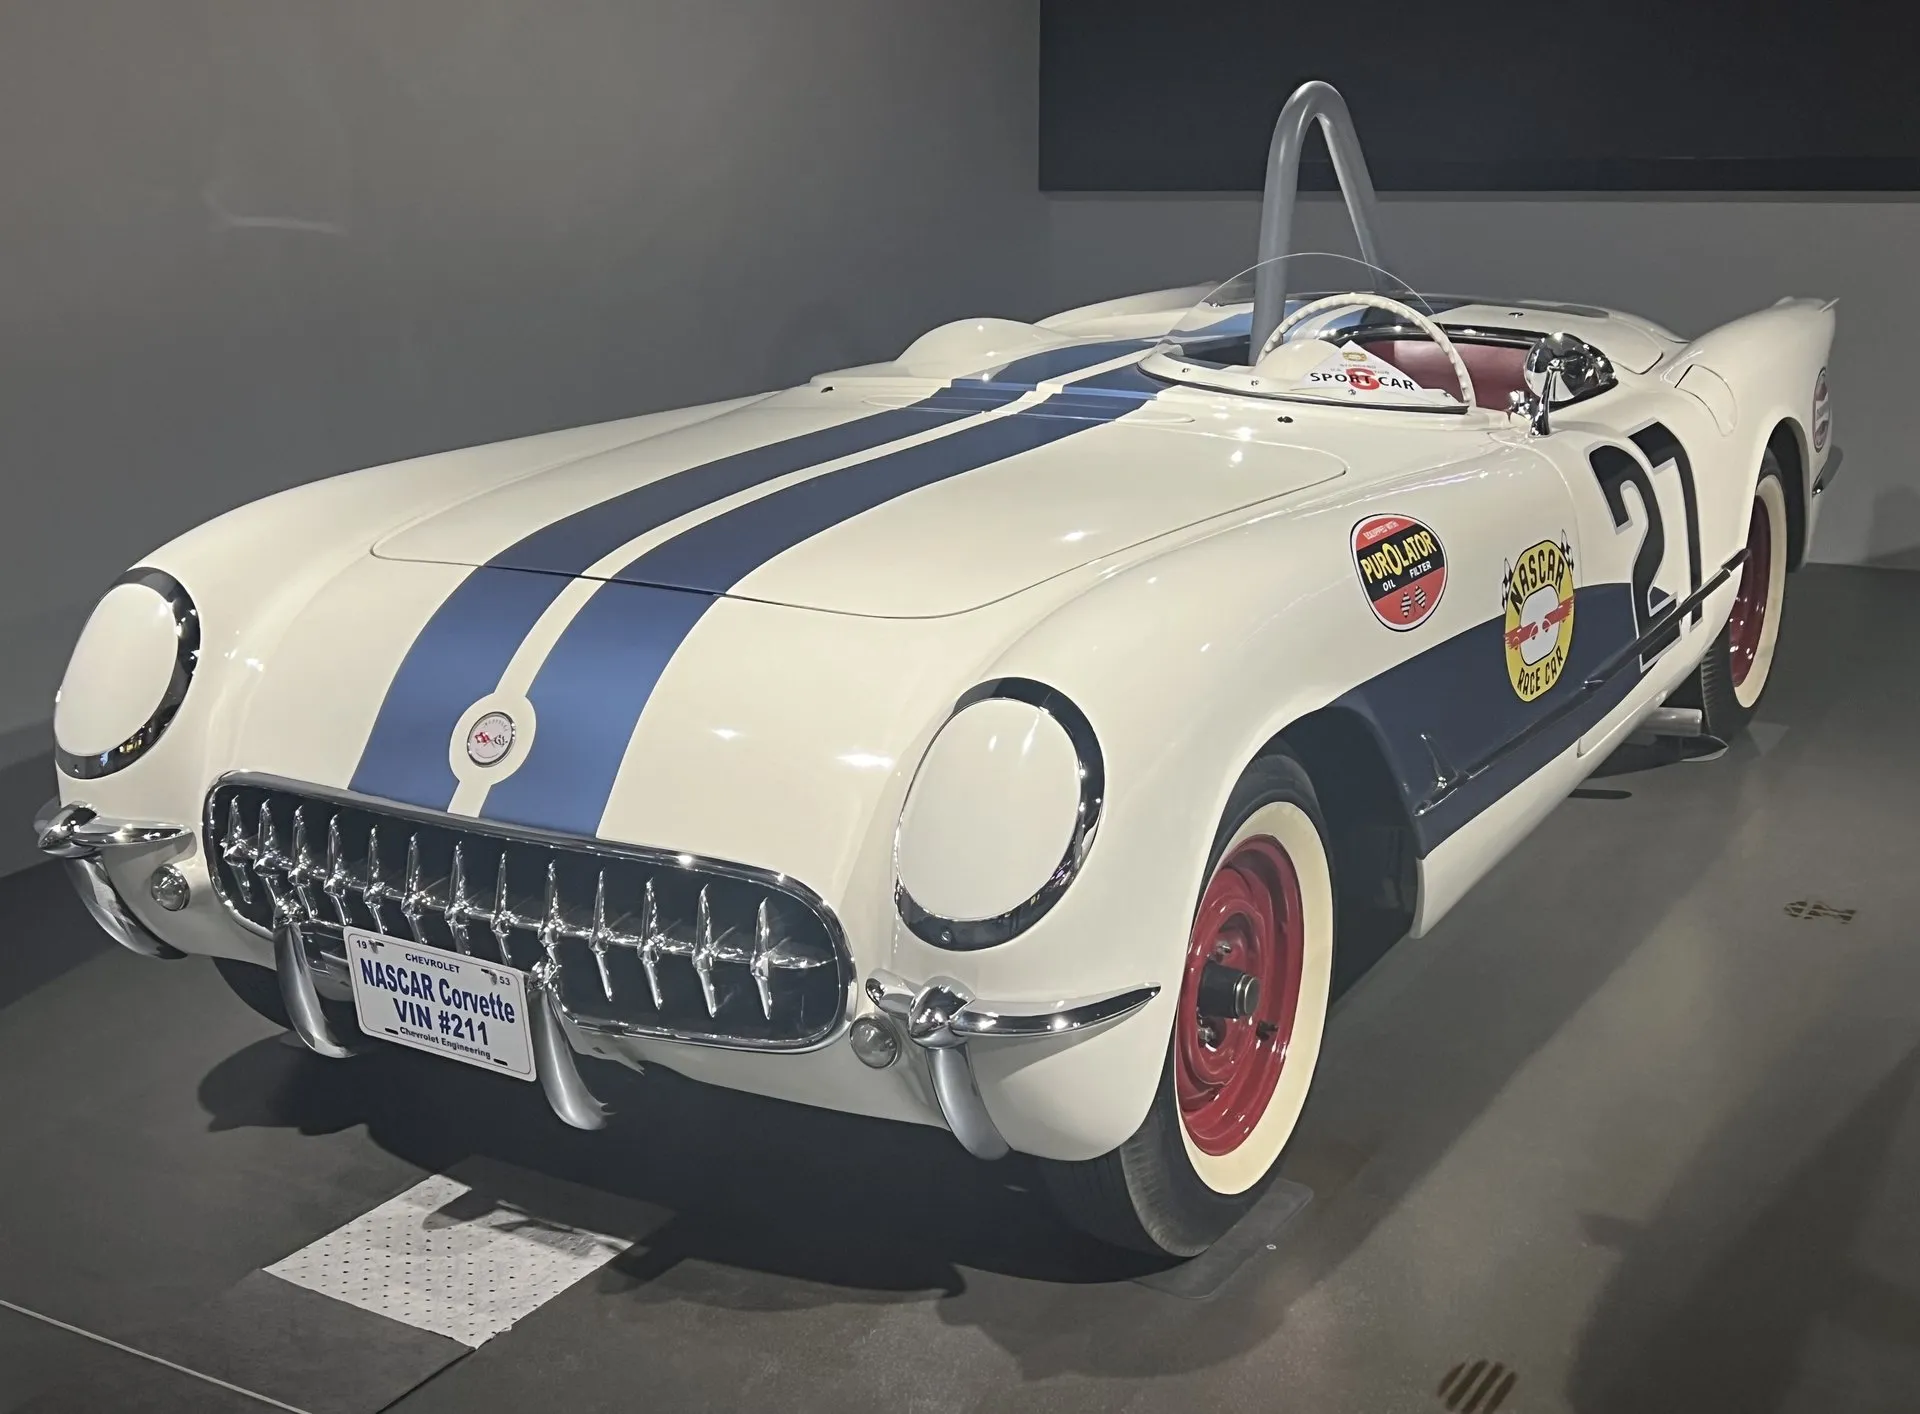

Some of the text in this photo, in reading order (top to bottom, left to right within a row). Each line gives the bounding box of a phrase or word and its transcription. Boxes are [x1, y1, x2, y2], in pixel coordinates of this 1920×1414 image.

[1310, 372, 1415, 391] SPORT CAR
[1360, 530, 1437, 583] PUROLATOR
[1382, 560, 1432, 591] OIL FILTER
[1510, 549, 1564, 615] NASCAR
[1517, 646, 1563, 695] RACE CAR
[356, 940, 367, 949] 19
[405, 953, 460, 973] CHEVROLET
[360, 958, 515, 1023] NASCAR Corvette
[499, 976, 510, 985] 53
[393, 998, 488, 1045] VIN #211
[400, 1026, 491, 1060] Chevrolet Engineering
